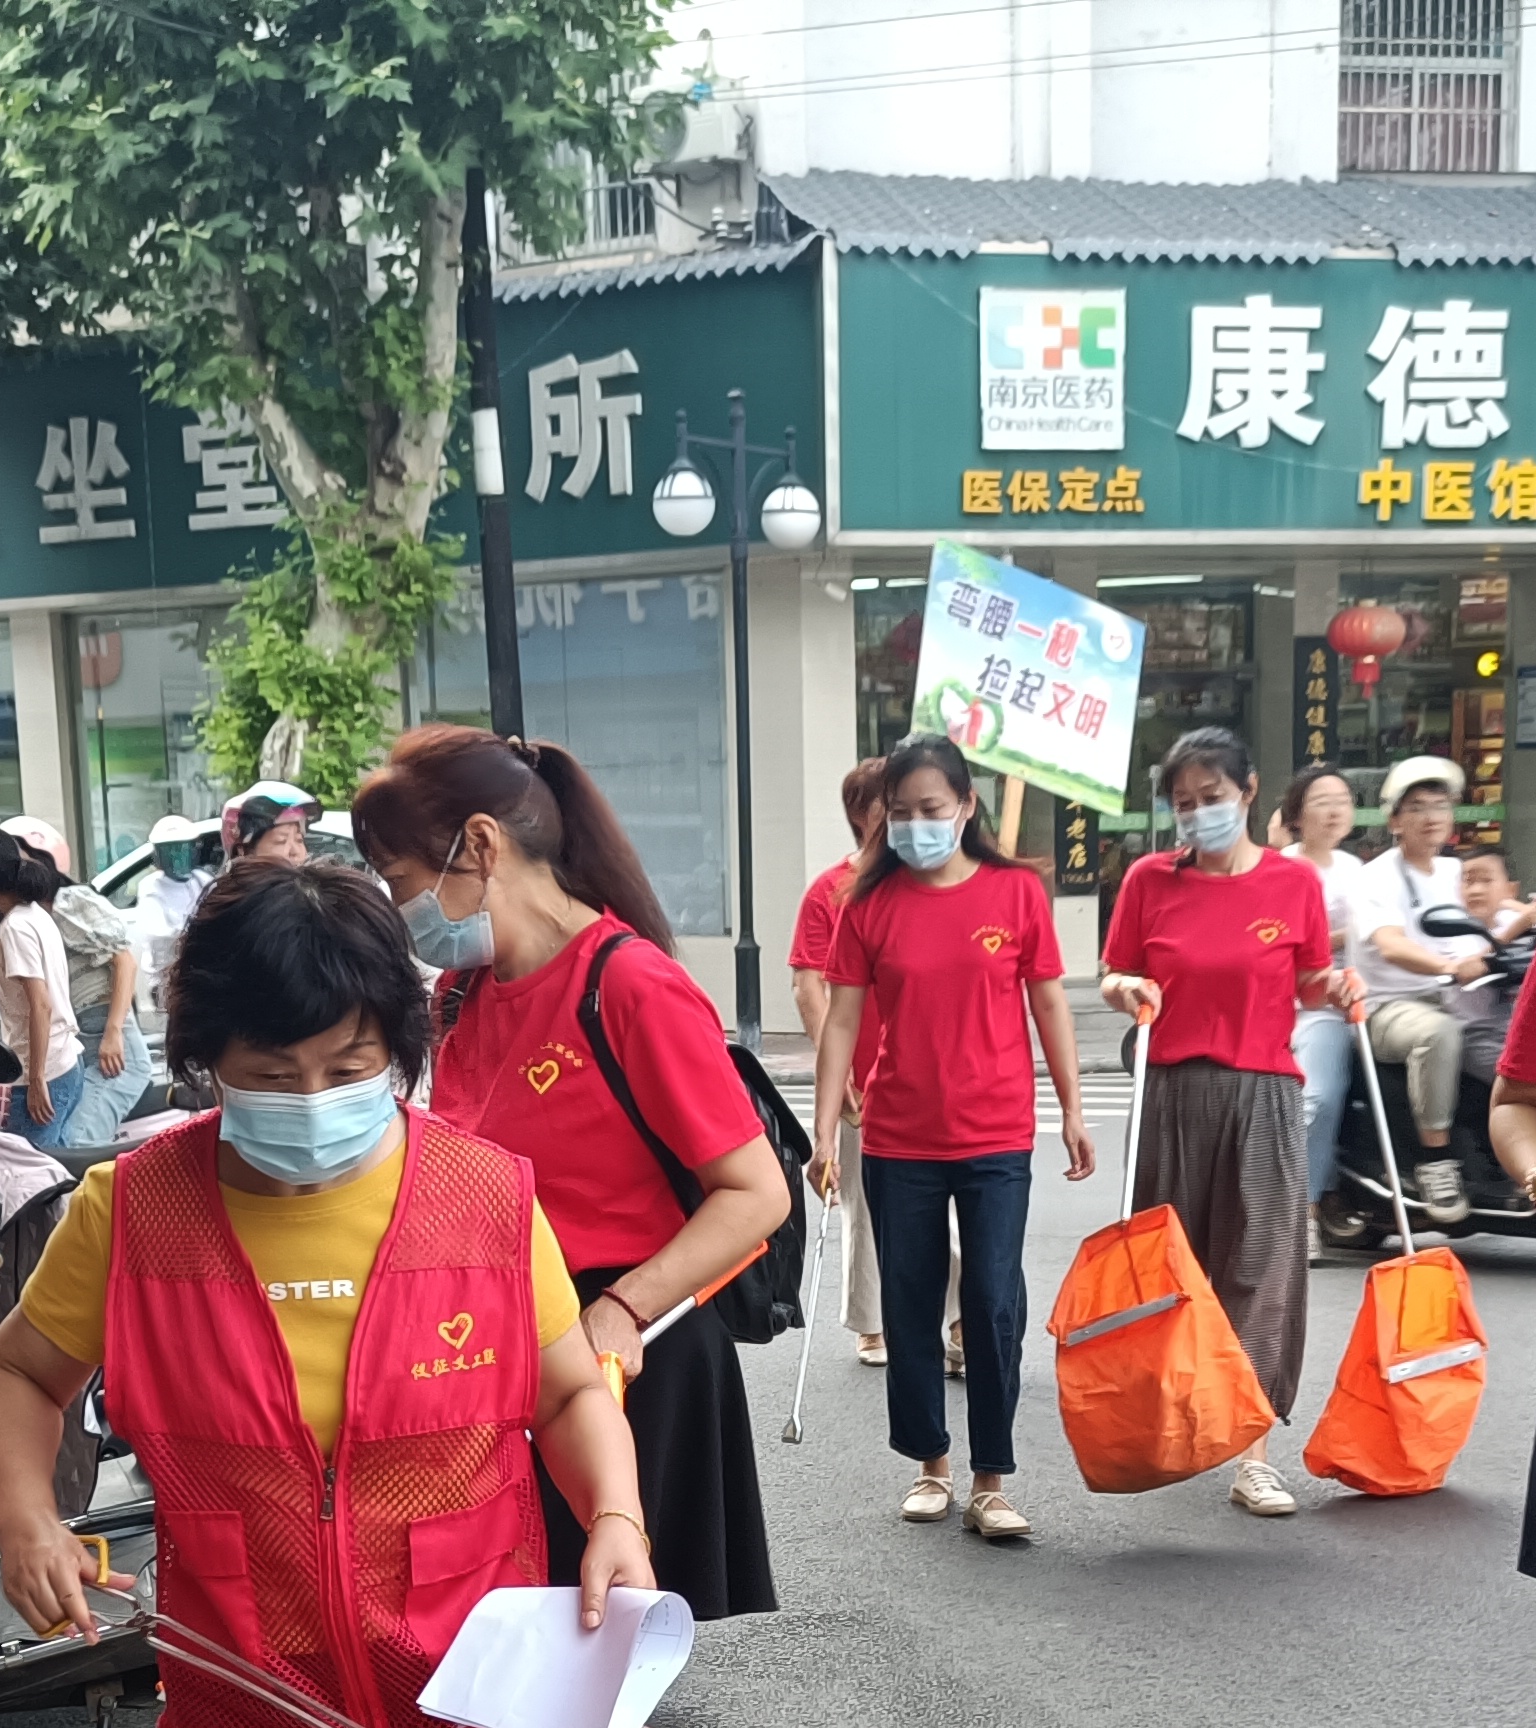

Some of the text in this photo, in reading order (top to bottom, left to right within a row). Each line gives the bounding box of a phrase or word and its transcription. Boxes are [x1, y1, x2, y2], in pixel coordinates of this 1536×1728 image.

[988, 375, 1114, 409] 南京医药
[962, 465, 1145, 513] 医保定点
[947, 581, 1079, 668] 弯腰一秒
[976, 654, 1108, 740] 捡起文明
[260, 1279, 356, 1301] STER
